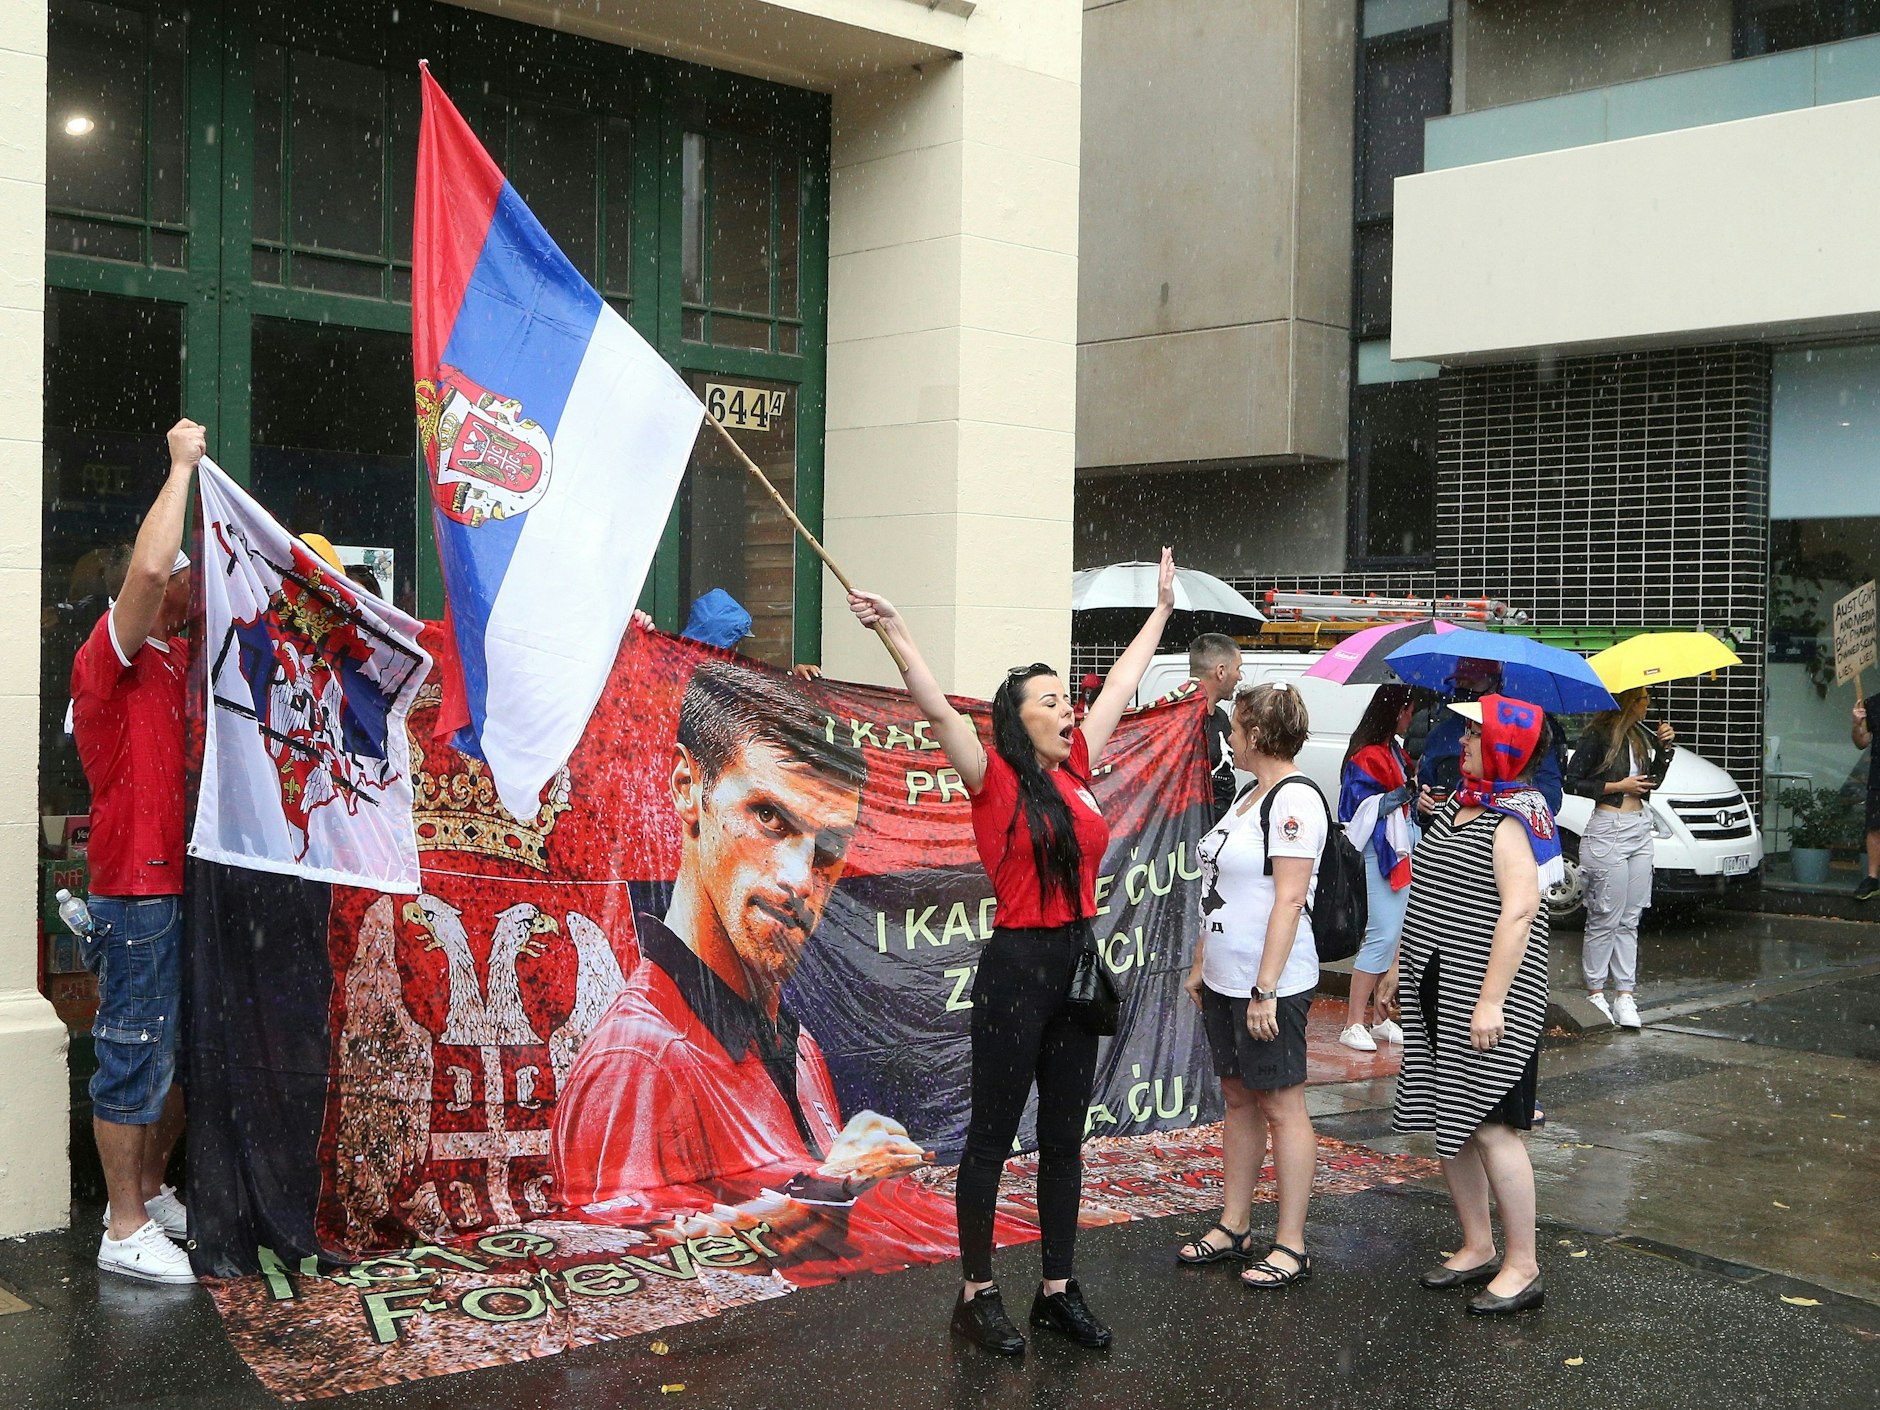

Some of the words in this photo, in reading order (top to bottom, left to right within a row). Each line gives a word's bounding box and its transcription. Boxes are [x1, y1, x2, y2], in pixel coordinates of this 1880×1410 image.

[1835, 596, 1858, 622] AUST
[1839, 617, 1853, 633] AND
[1838, 664, 1853, 679] LIES
[1859, 650, 1874, 665] LIES
[364, 1222, 778, 1344] Forever
